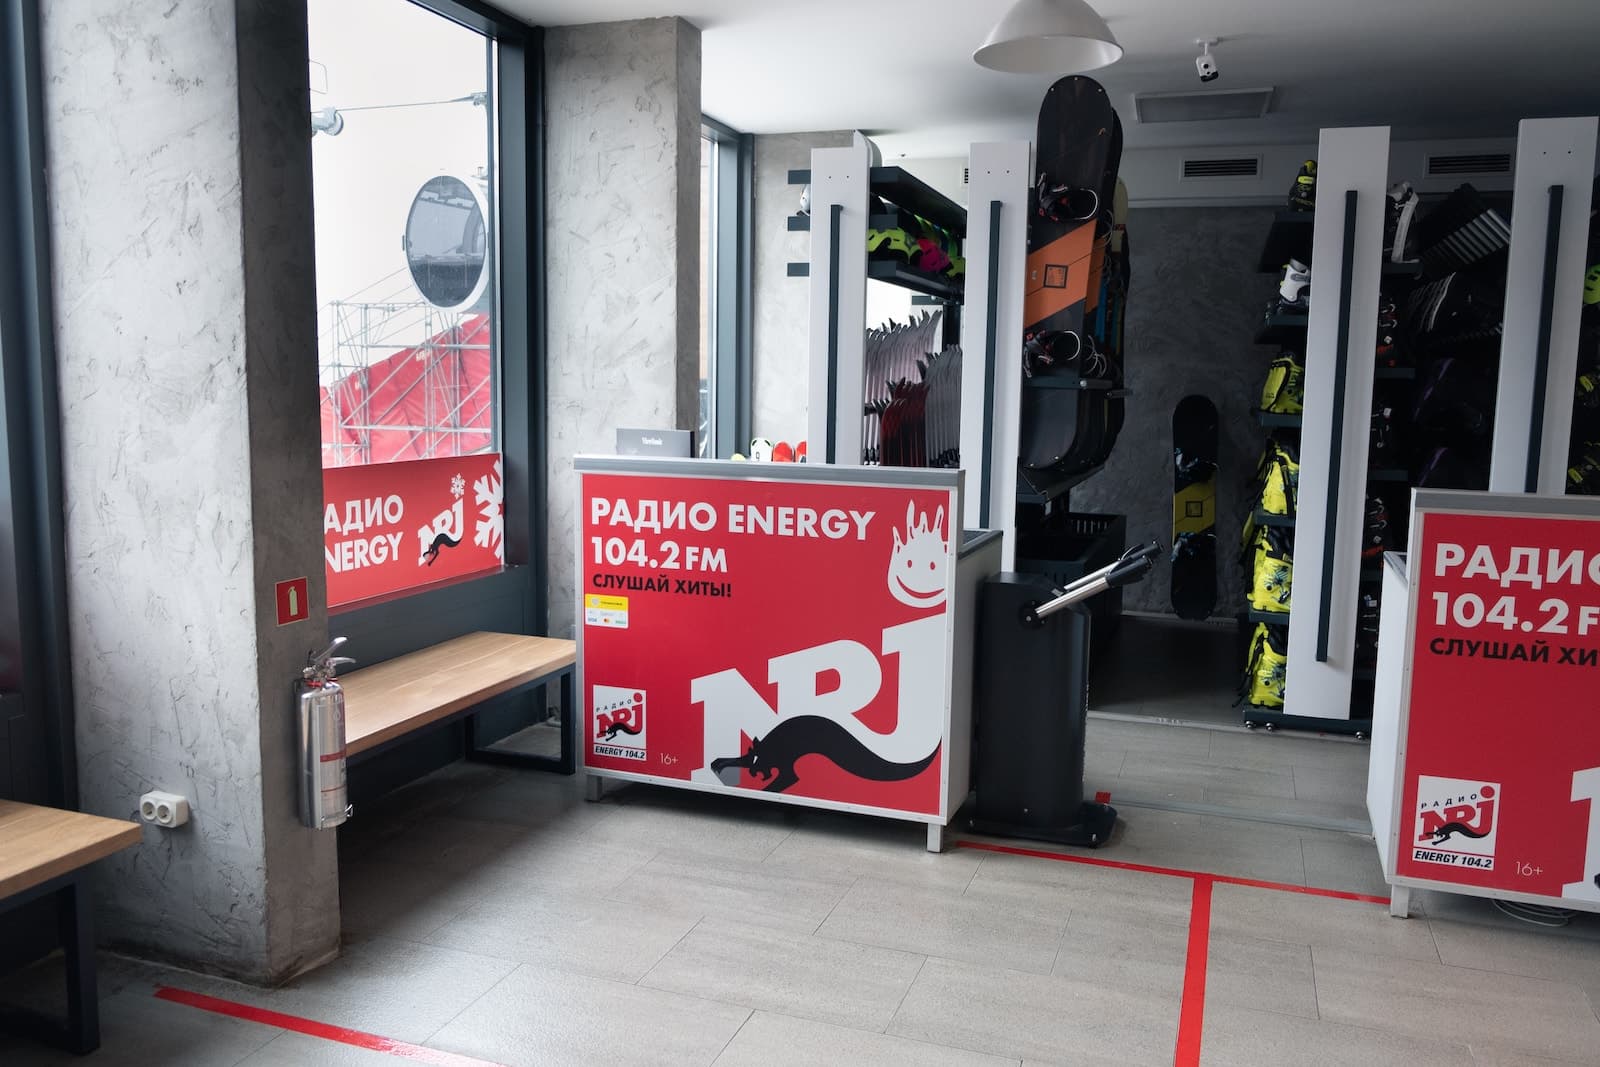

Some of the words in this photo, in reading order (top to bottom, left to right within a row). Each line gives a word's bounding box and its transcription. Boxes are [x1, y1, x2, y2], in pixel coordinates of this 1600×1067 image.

[417, 498, 464, 567] NRJ
[591, 497, 718, 535] РАДИО
[728, 503, 876, 541] ENERGY
[591, 536, 681, 570] 104.2
[685, 546, 728, 573] FM
[1434, 542, 1600, 590] РАДИ
[592, 573, 670, 594] СЛУШАЙ
[674, 579, 732, 598] ХИТЫ!
[1432, 591, 1570, 635] 104.2
[1429, 637, 1550, 664] СЛУШАЙ
[1557, 646, 1600, 667] ХИ
[596, 692, 643, 739] NRJ
[690, 612, 947, 787] NRJ
[595, 745, 623, 756] ENERGY
[625, 750, 645, 759] 104.2
[660, 753, 678, 765] 16+
[1418, 785, 1496, 842] NRJ
[1420, 793, 1478, 810] РАДИО
[1414, 850, 1458, 863] ENERGY
[1461, 856, 1492, 868] 104.2
[1515, 861, 1544, 877] 16+
